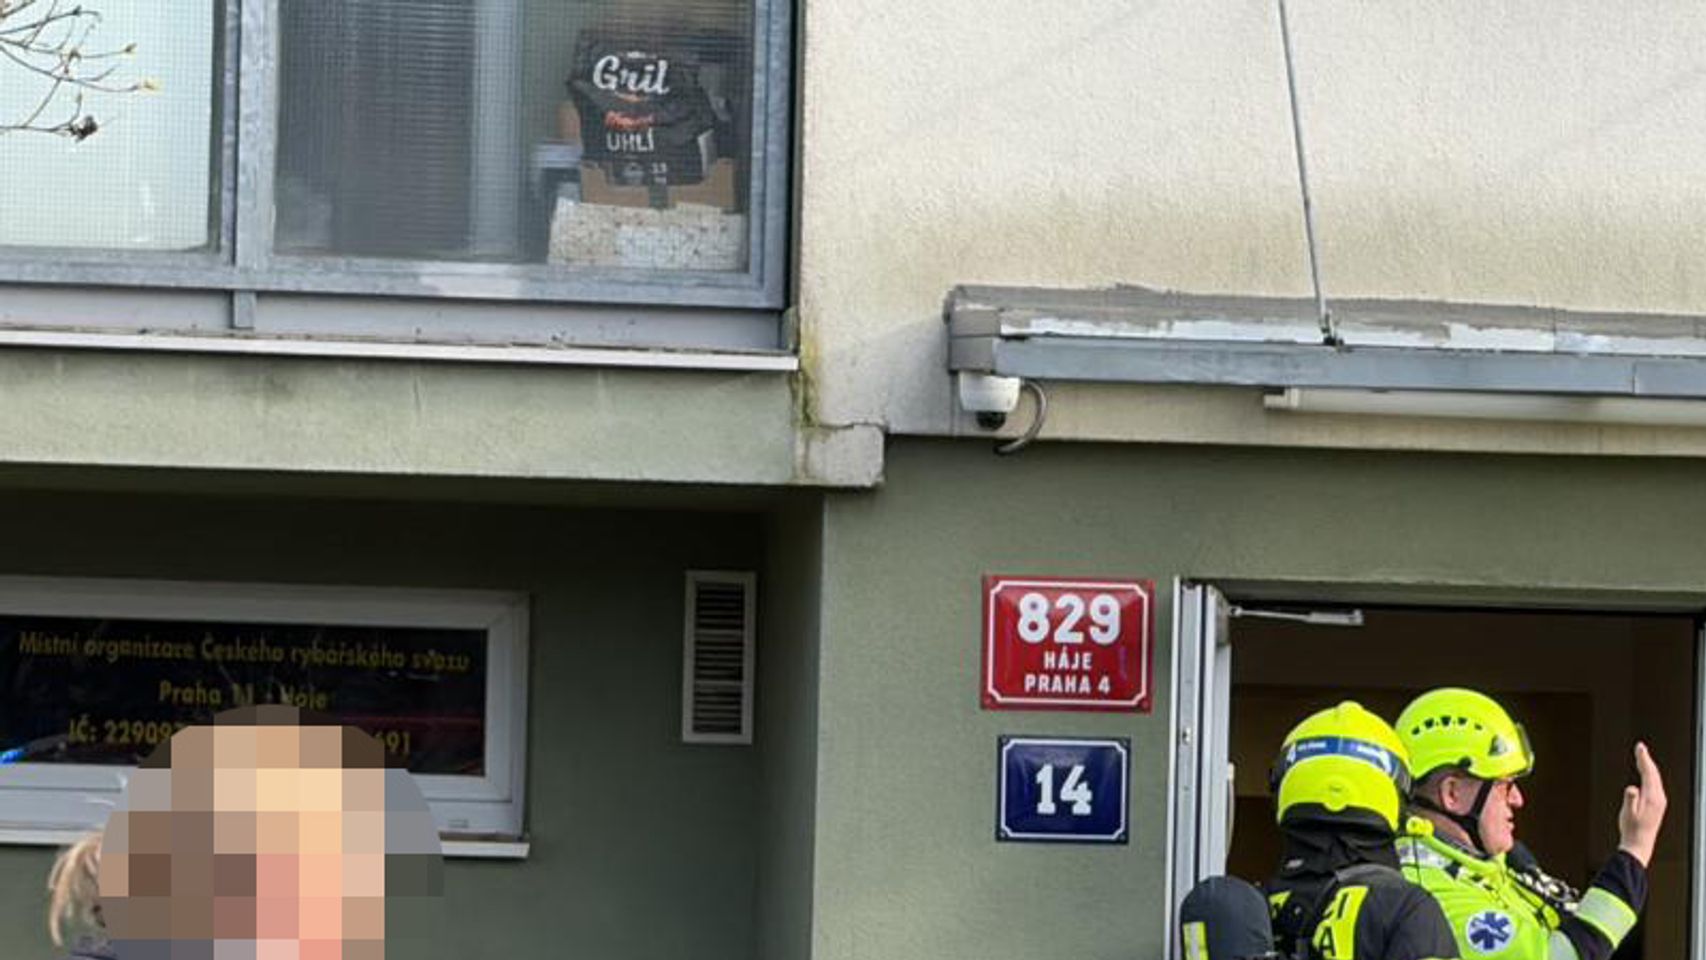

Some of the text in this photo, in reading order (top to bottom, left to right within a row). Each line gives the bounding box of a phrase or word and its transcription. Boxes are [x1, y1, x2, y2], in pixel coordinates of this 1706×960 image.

[593, 55, 670, 94] Gril
[1017, 592, 1122, 644] 829
[1044, 646, 1093, 671] HÁJE
[160, 679, 222, 705] Praha
[1024, 673, 1110, 694] PRAHA 4
[1036, 763, 1093, 815] 14
